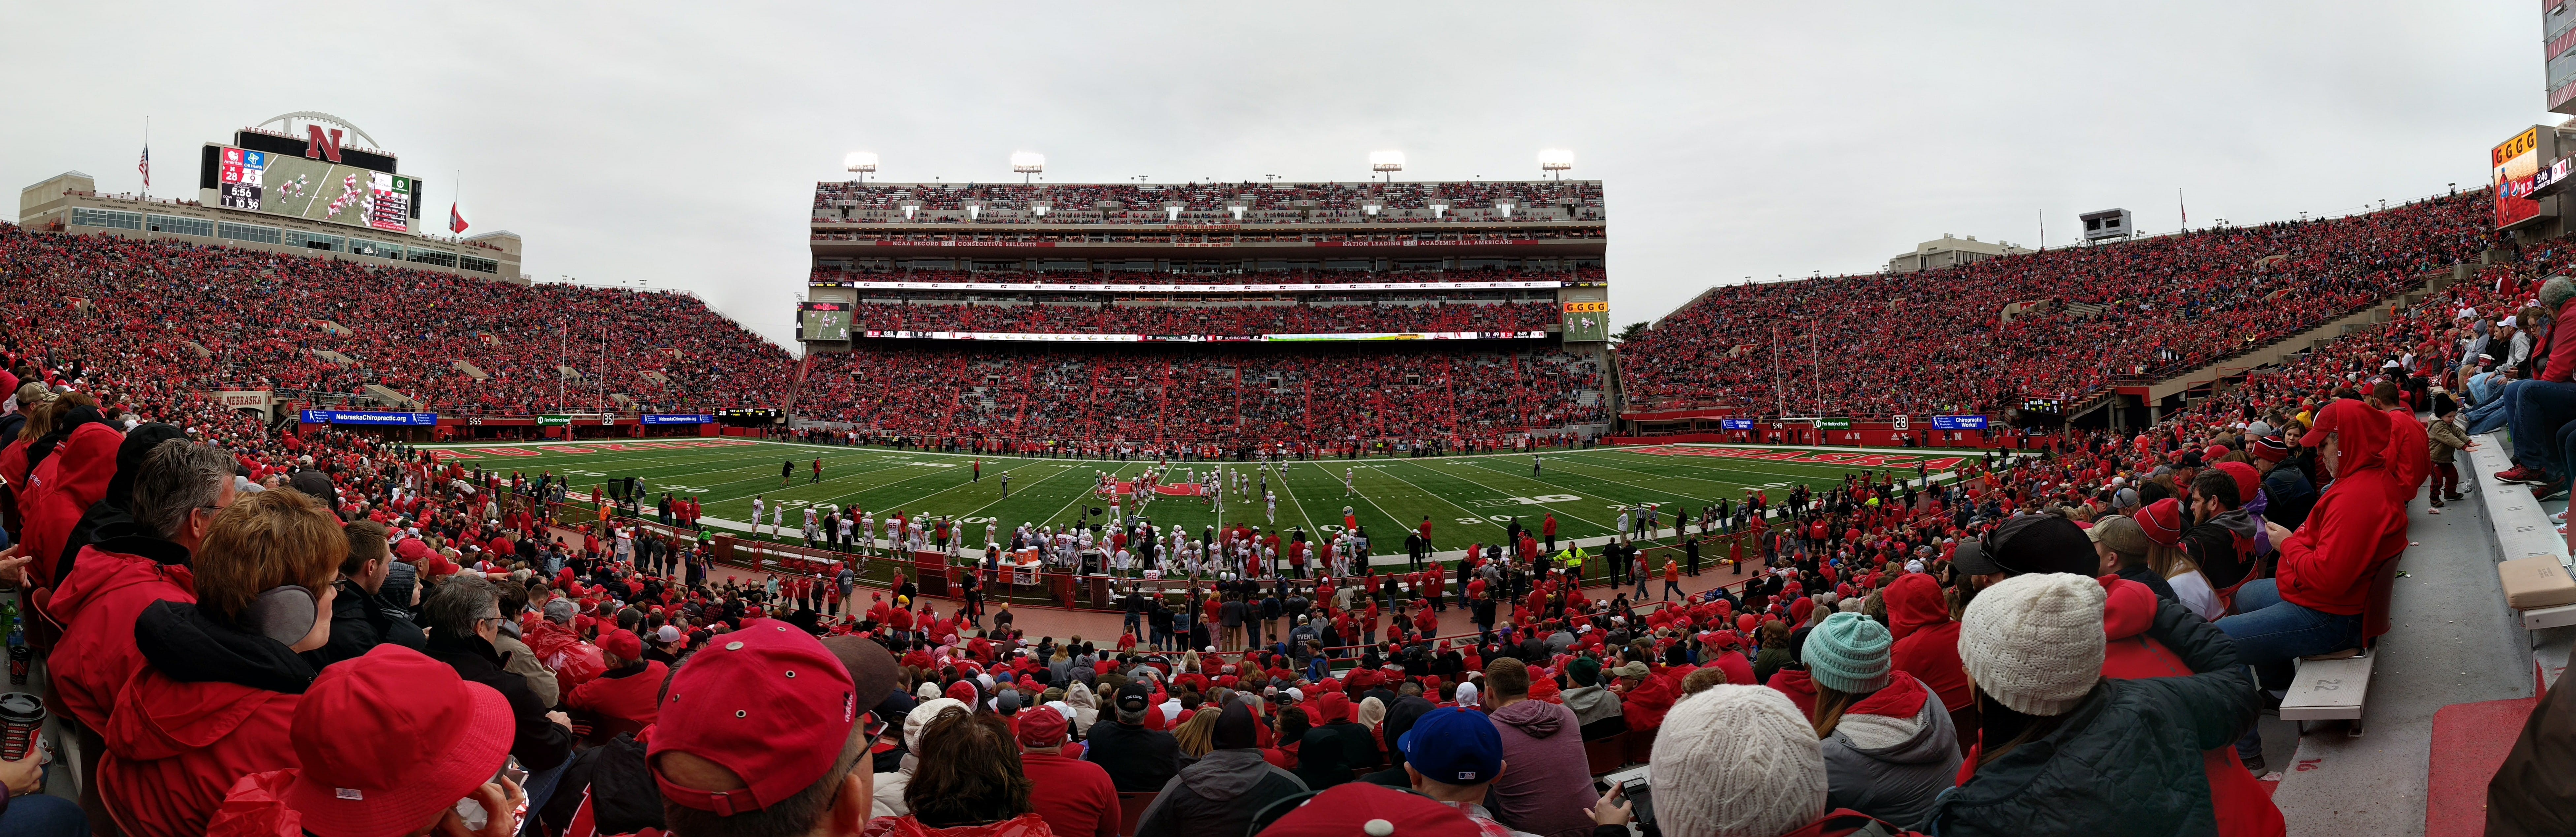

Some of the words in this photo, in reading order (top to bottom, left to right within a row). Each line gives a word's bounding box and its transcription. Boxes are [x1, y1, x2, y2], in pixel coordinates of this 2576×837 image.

[245, 126, 301, 140] MEMORIAL
[306, 124, 343, 163] N
[2497, 148, 2502, 164] G
[2506, 143, 2512, 158] G
[2516, 137, 2523, 153] G
[2527, 131, 2534, 148] G
[345, 143, 395, 158] STADIUM
[2560, 162, 2565, 174] N
[2568, 157, 2571, 169] 1
[226, 171, 237, 181] 28
[2537, 170, 2548, 183] 5:46
[2554, 168, 2557, 177] 9
[2521, 183, 2526, 194] N
[2527, 180, 2532, 190] 28
[2538, 179, 2550, 190] QUARTER
[232, 187, 252, 198] 5:56
[236, 199, 245, 208] 10
[247, 201, 259, 210] 39
[227, 395, 261, 405] NEBRASKA
[267, 395, 272, 404] N
[2054, 405, 2057, 414] 9
[336, 414, 406, 422] NebraskaChiropractic.org
[604, 415, 612, 423] 35
[1896, 417, 1906, 428] 28
[1620, 446, 1967, 469] NEBRASKA
[12, 660, 27, 675] N
[2314, 679, 2341, 691] 22
